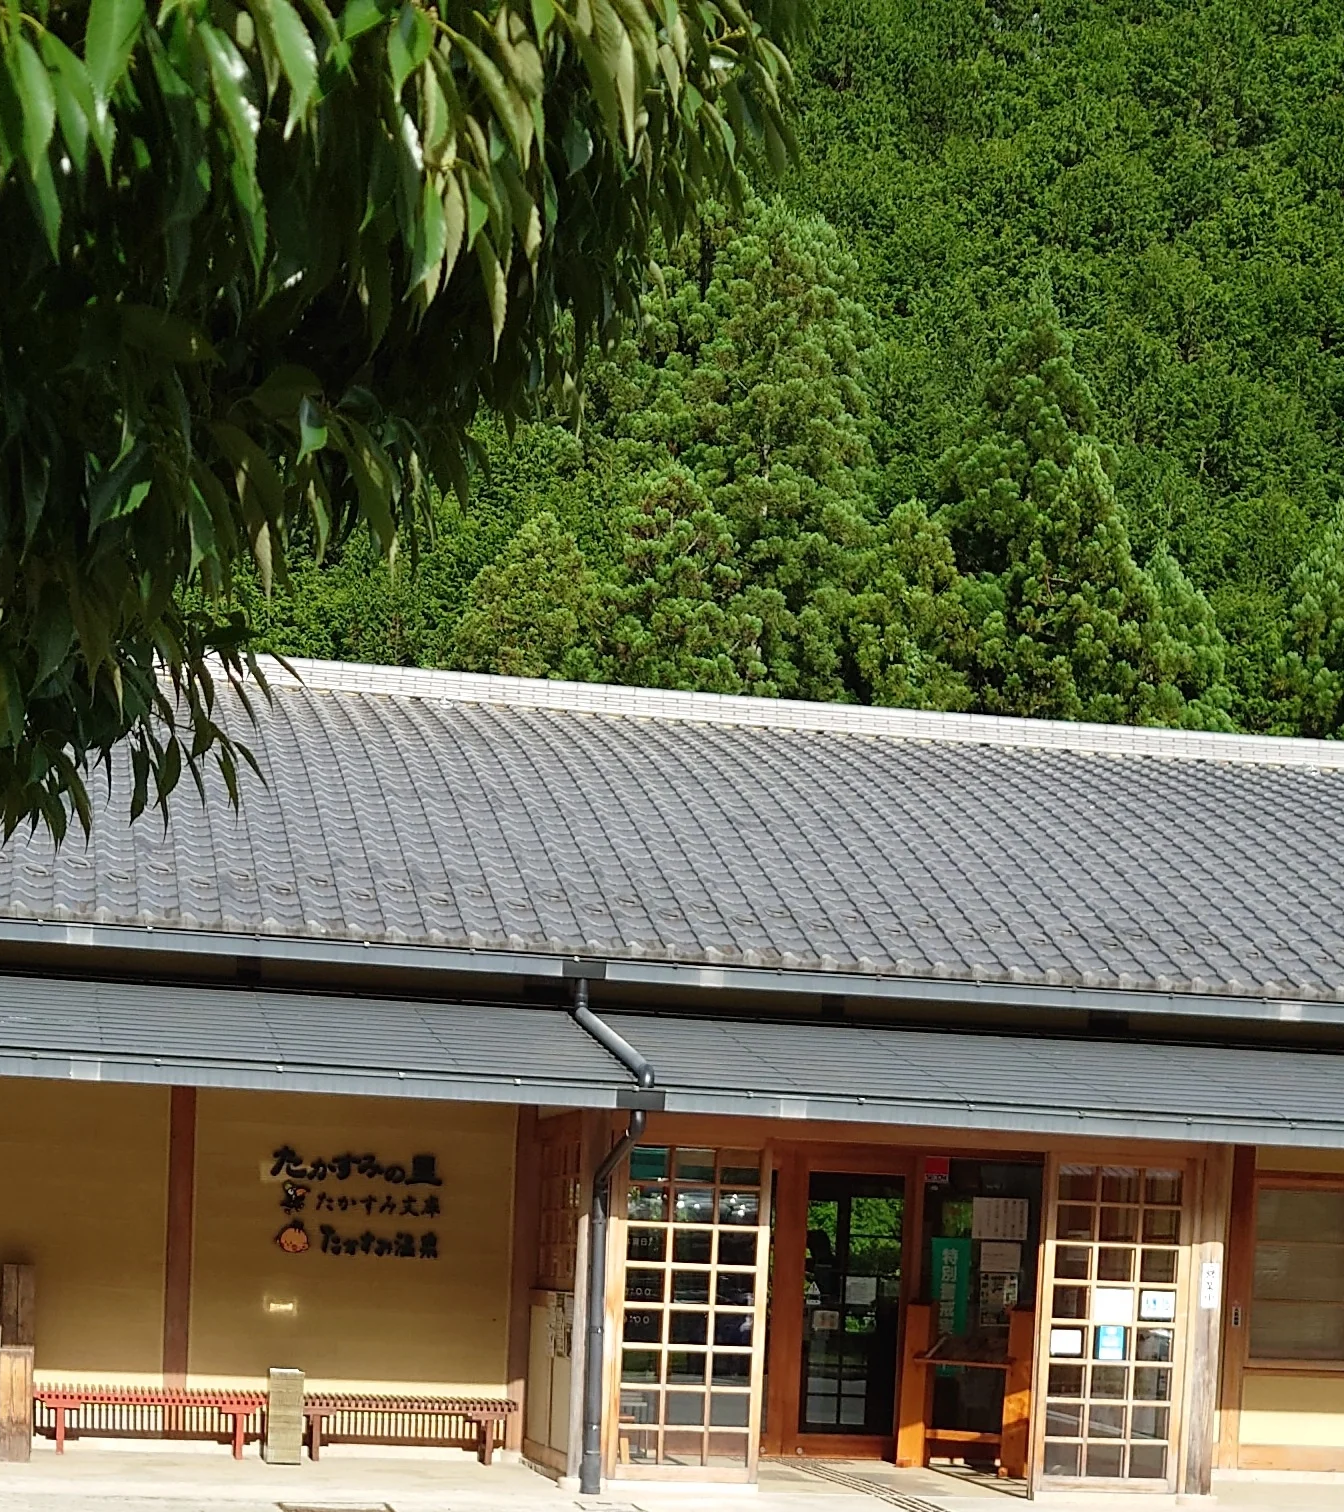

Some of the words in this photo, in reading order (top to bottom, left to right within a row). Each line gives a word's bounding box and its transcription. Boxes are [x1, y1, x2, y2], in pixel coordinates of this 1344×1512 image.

[270, 1145, 442, 1185] たかすみの里
[316, 1192, 441, 1218] たかすみ文庫
[320, 1224, 438, 1259] たかすみ温泉
